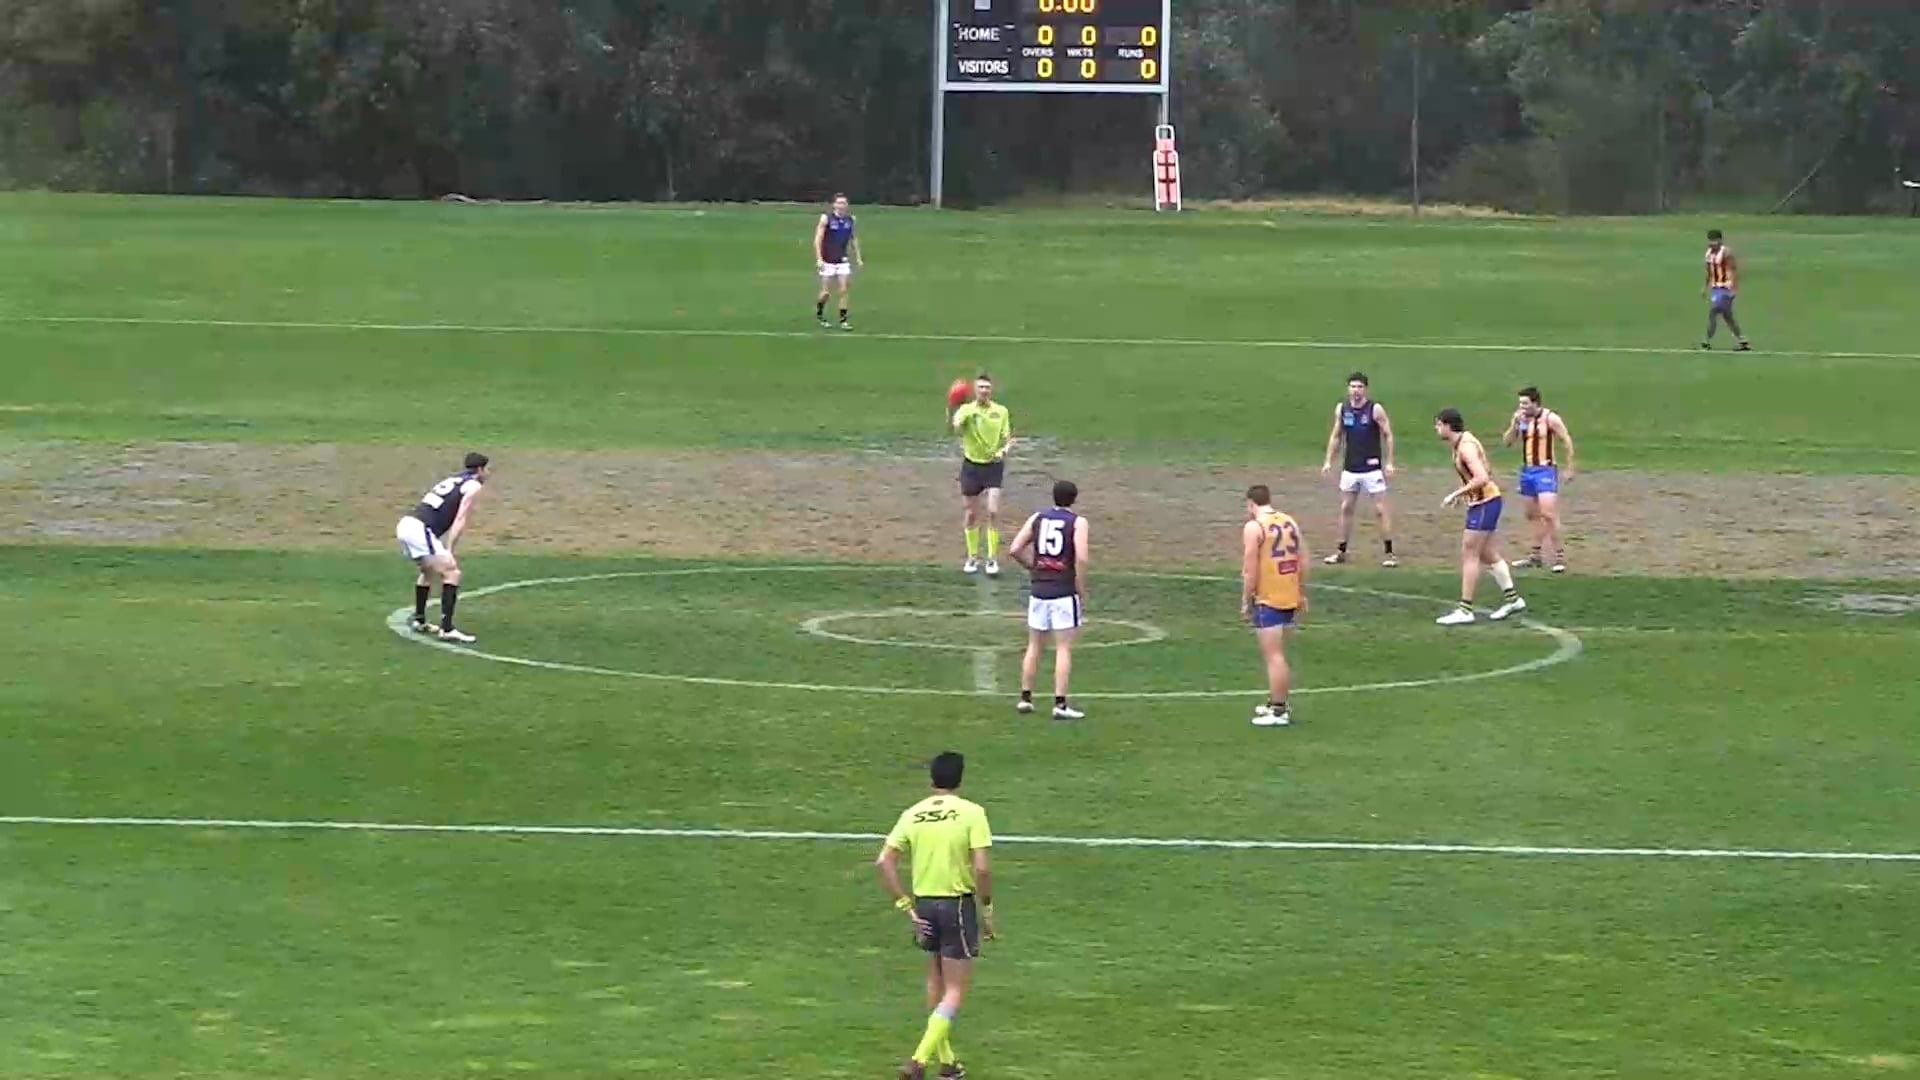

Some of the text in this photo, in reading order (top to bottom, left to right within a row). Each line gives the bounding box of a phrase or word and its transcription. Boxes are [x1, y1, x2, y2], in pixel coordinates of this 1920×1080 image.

[958, 25, 1156, 46] HOME 0 0 0
[1022, 47, 1144, 58] OVERS WKTS RUNS
[958, 58, 1155, 78] VISITORS 0 0 0
[1038, 518, 1065, 556] 15
[1269, 521, 1299, 557] 23
[913, 810, 959, 824] SSA
